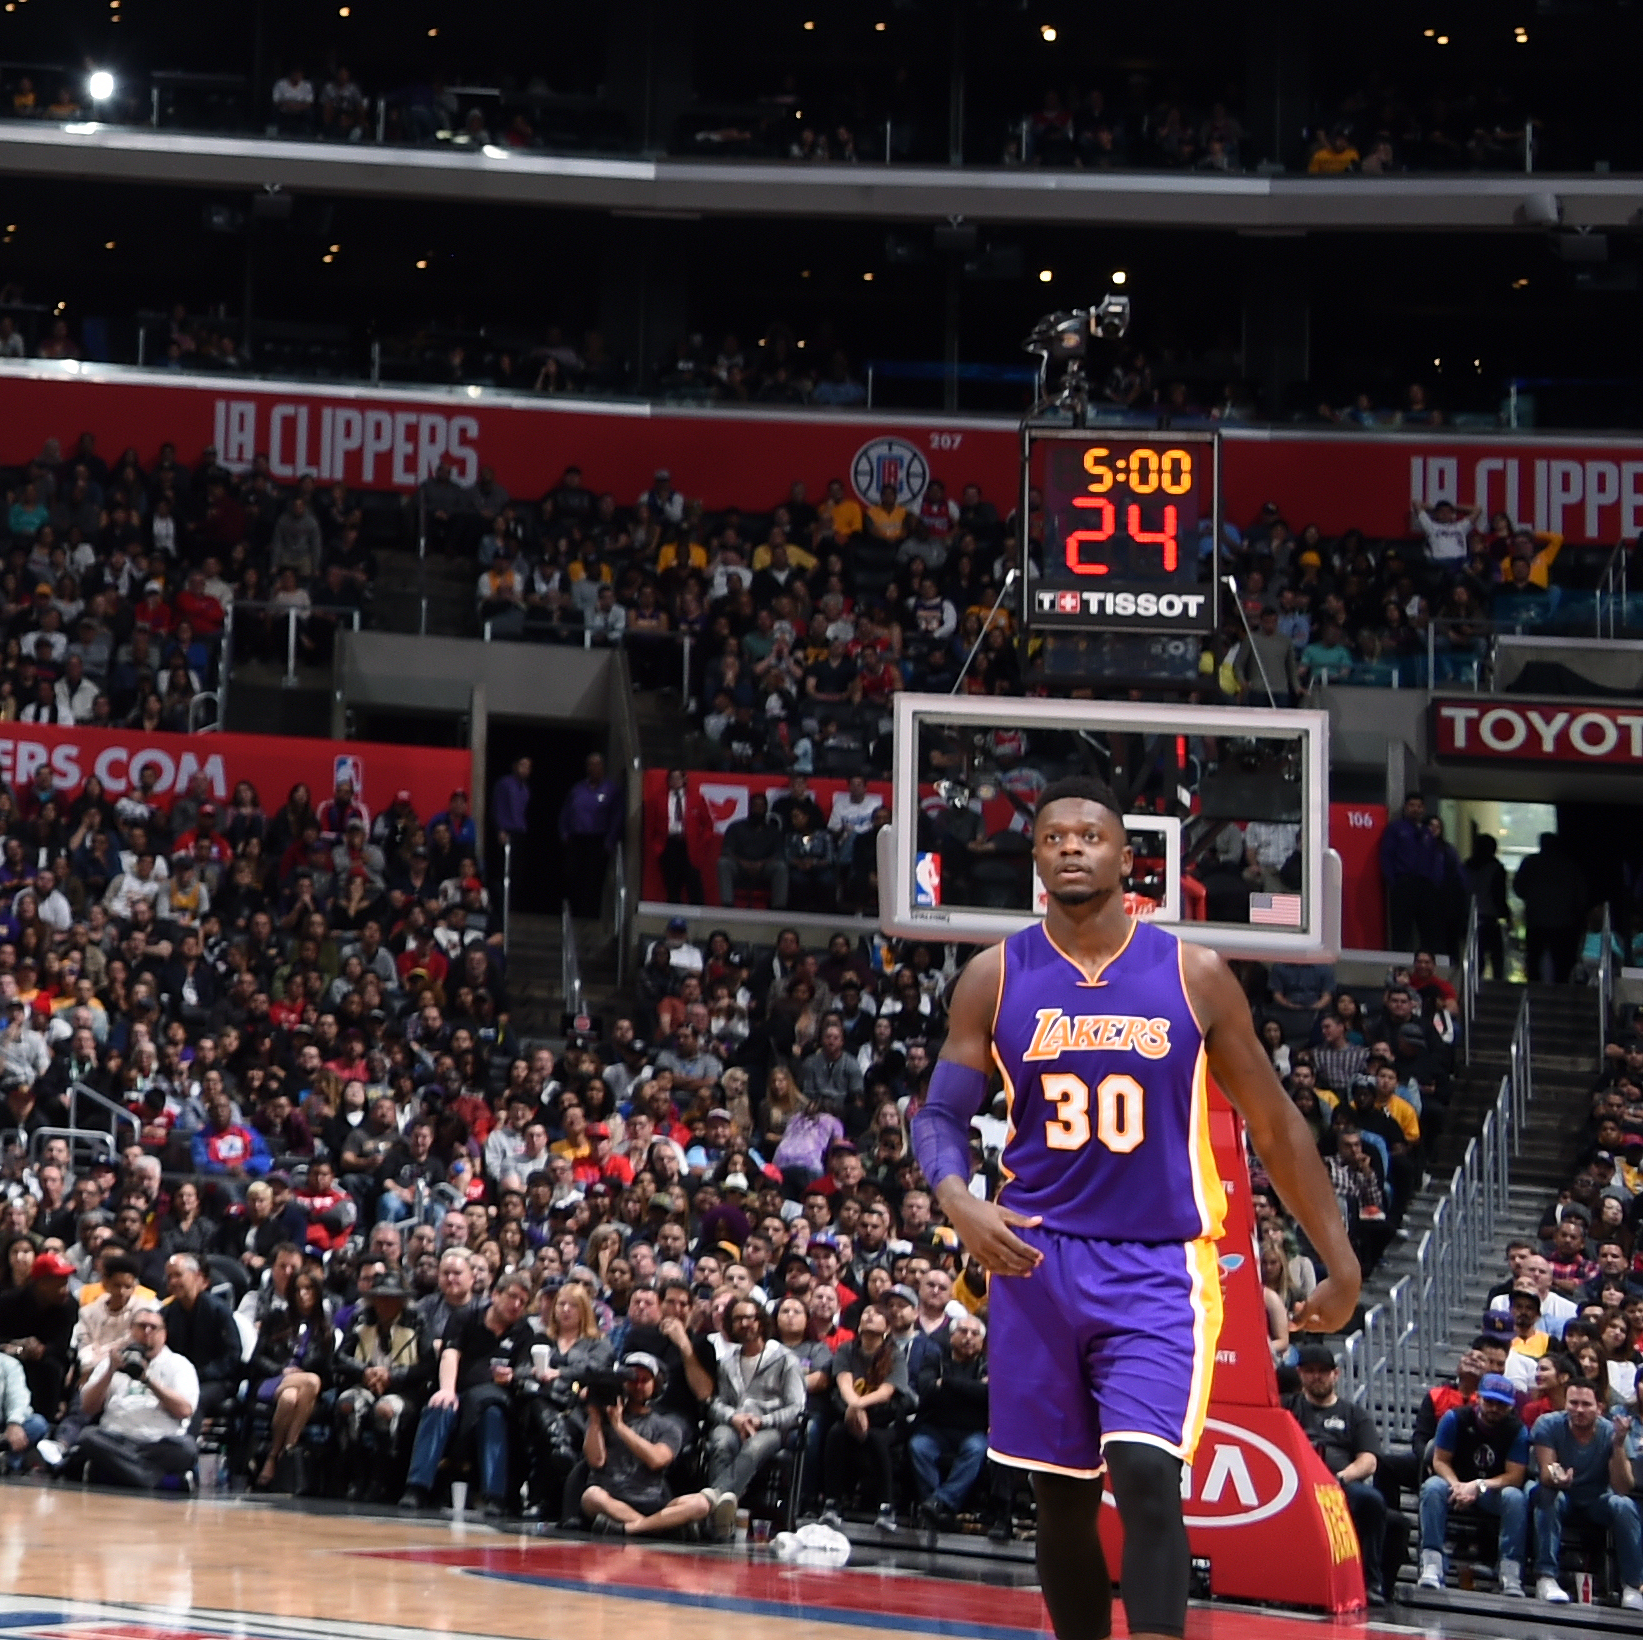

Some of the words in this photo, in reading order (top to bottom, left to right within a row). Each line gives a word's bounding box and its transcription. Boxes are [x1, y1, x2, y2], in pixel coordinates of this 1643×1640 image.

[268, 404, 479, 488] CLIPPERS
[929, 432, 962, 450] 207
[1083, 447, 1192, 494] 5:00
[1475, 457, 1643, 538] CLIPPE
[1065, 496, 1177, 574] 24
[1081, 591, 1205, 618] TISSOT
[1441, 706, 1643, 759] TOYOT
[1347, 811, 1373, 828] 106
[1023, 1008, 1171, 1062] LAKERS
[1041, 1073, 1144, 1153] 30
